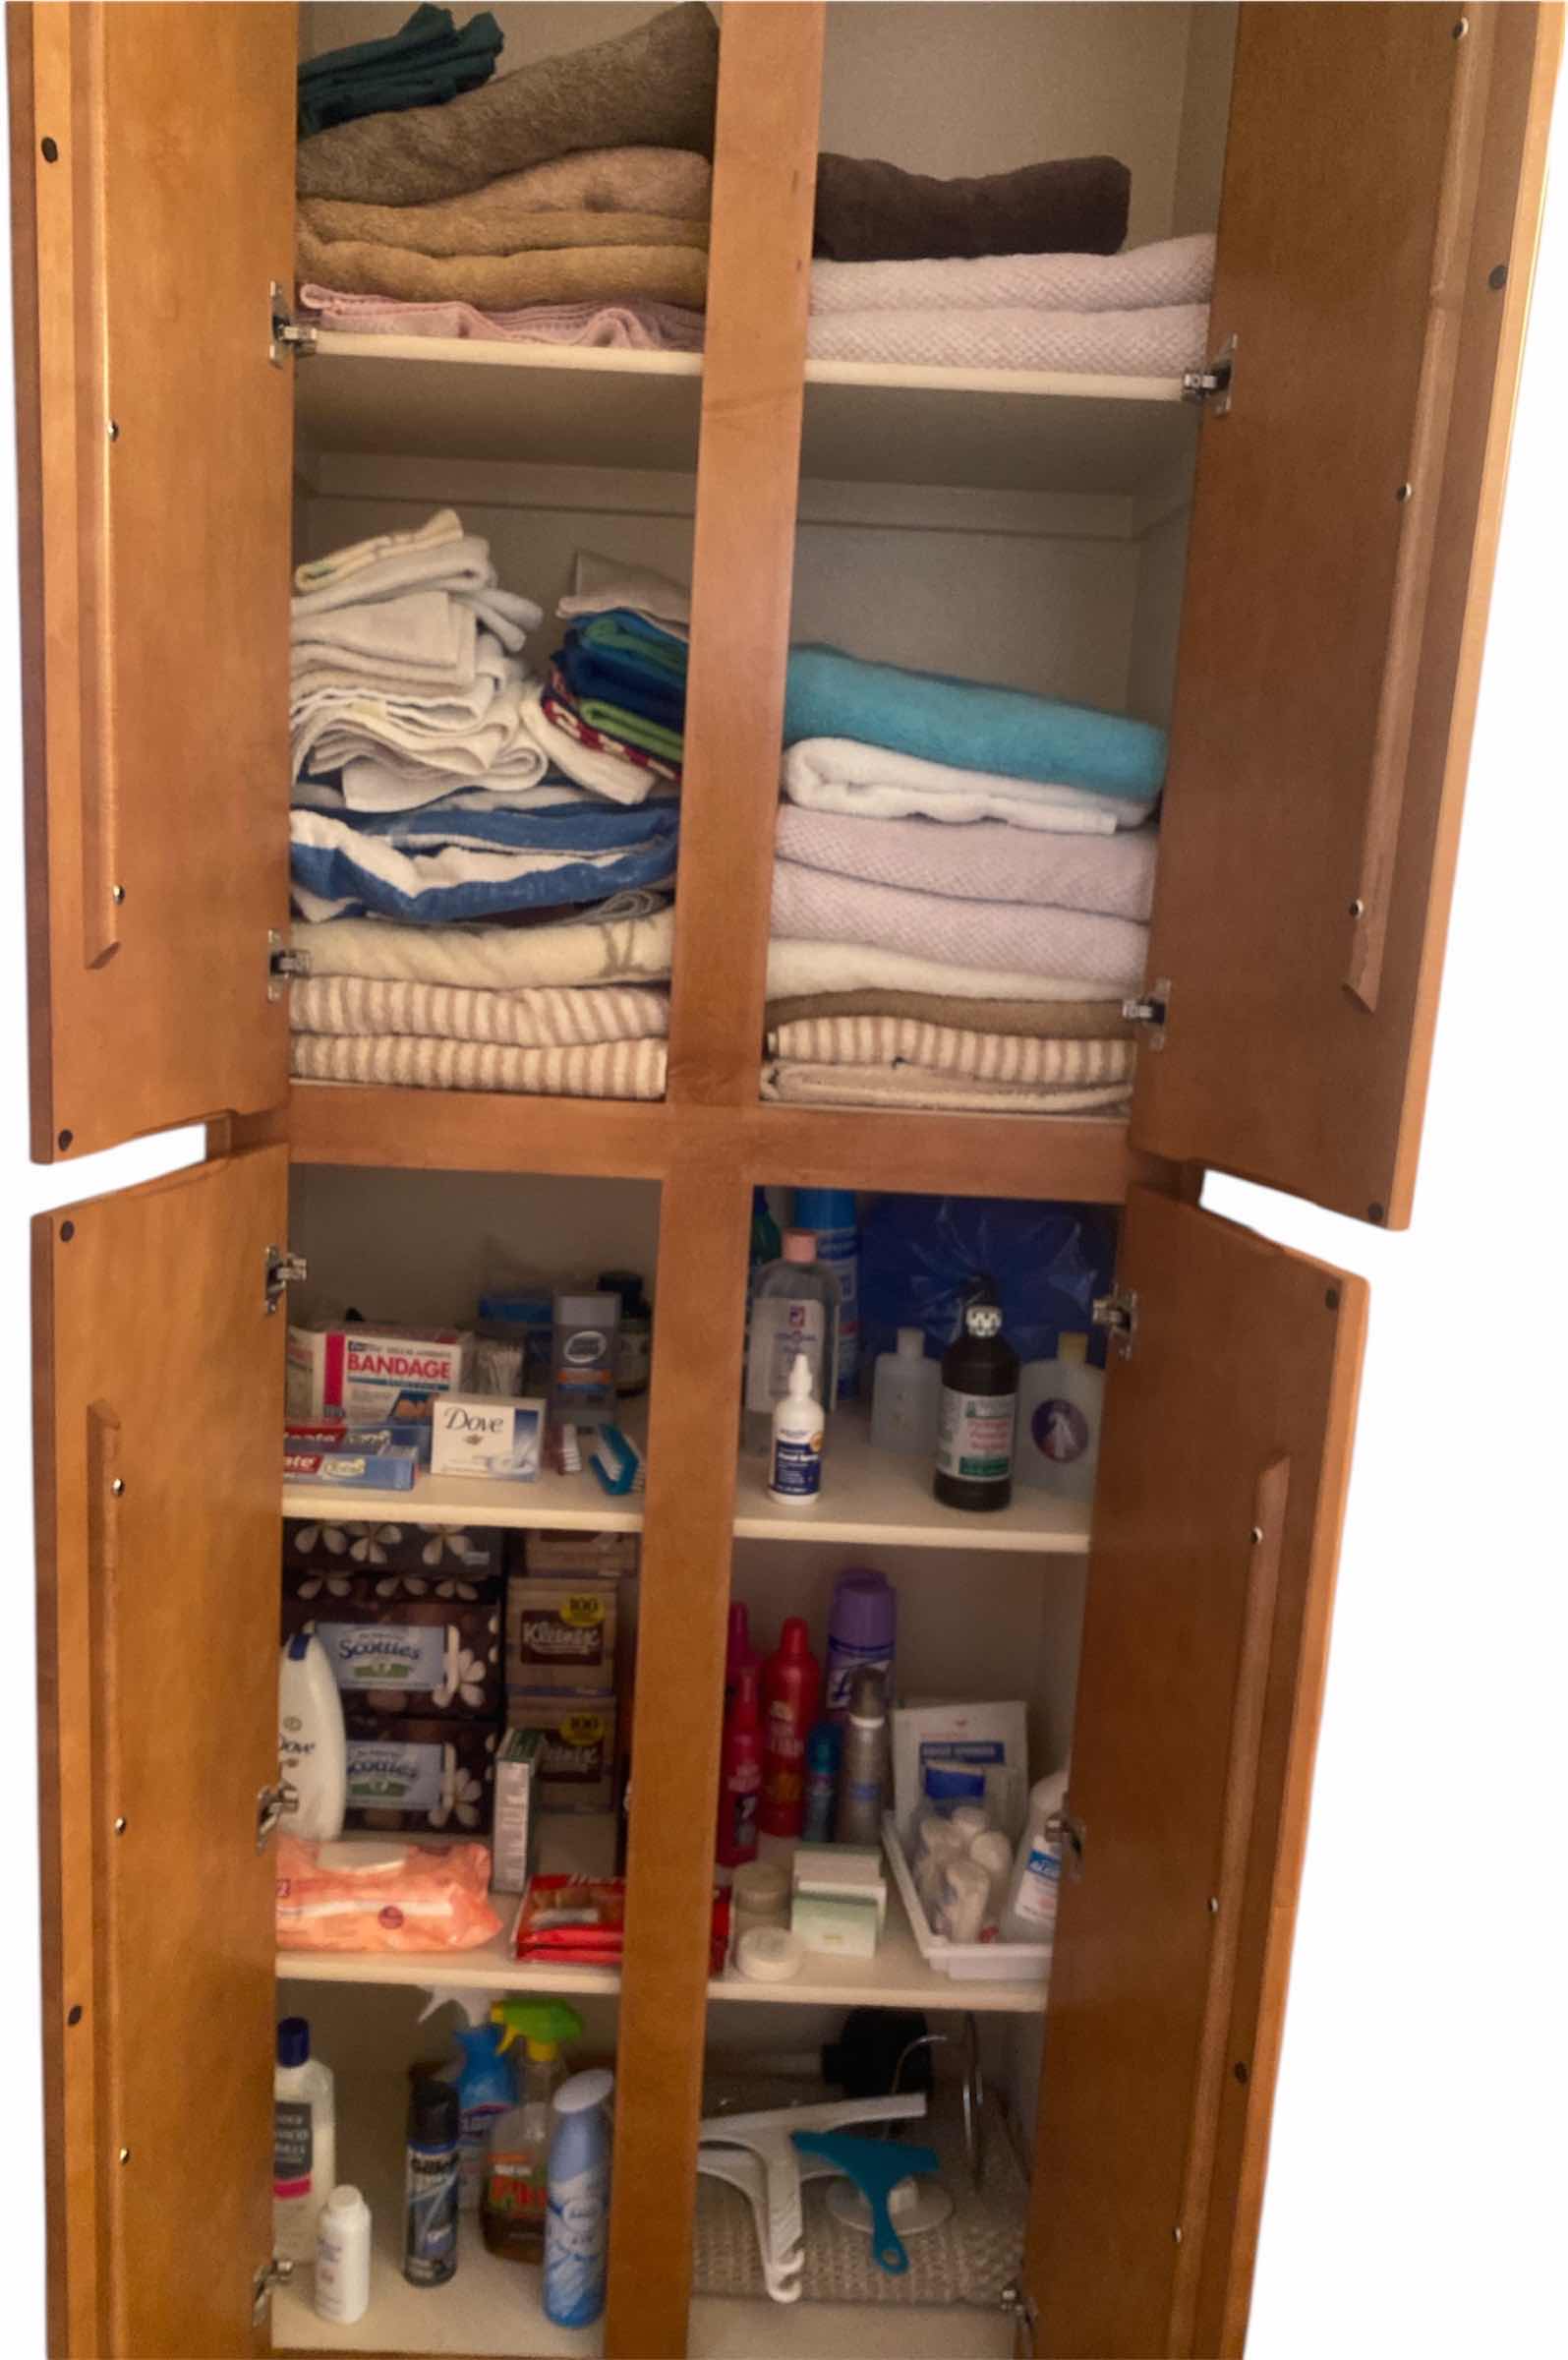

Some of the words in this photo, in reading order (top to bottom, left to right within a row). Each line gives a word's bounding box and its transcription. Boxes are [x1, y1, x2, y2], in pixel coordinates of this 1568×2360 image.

[348, 1353, 451, 1380] BANDAGE
[444, 1407, 503, 1433] Dove
[339, 1639, 421, 1661] Scotties
[346, 1759, 418, 1779] cotties
